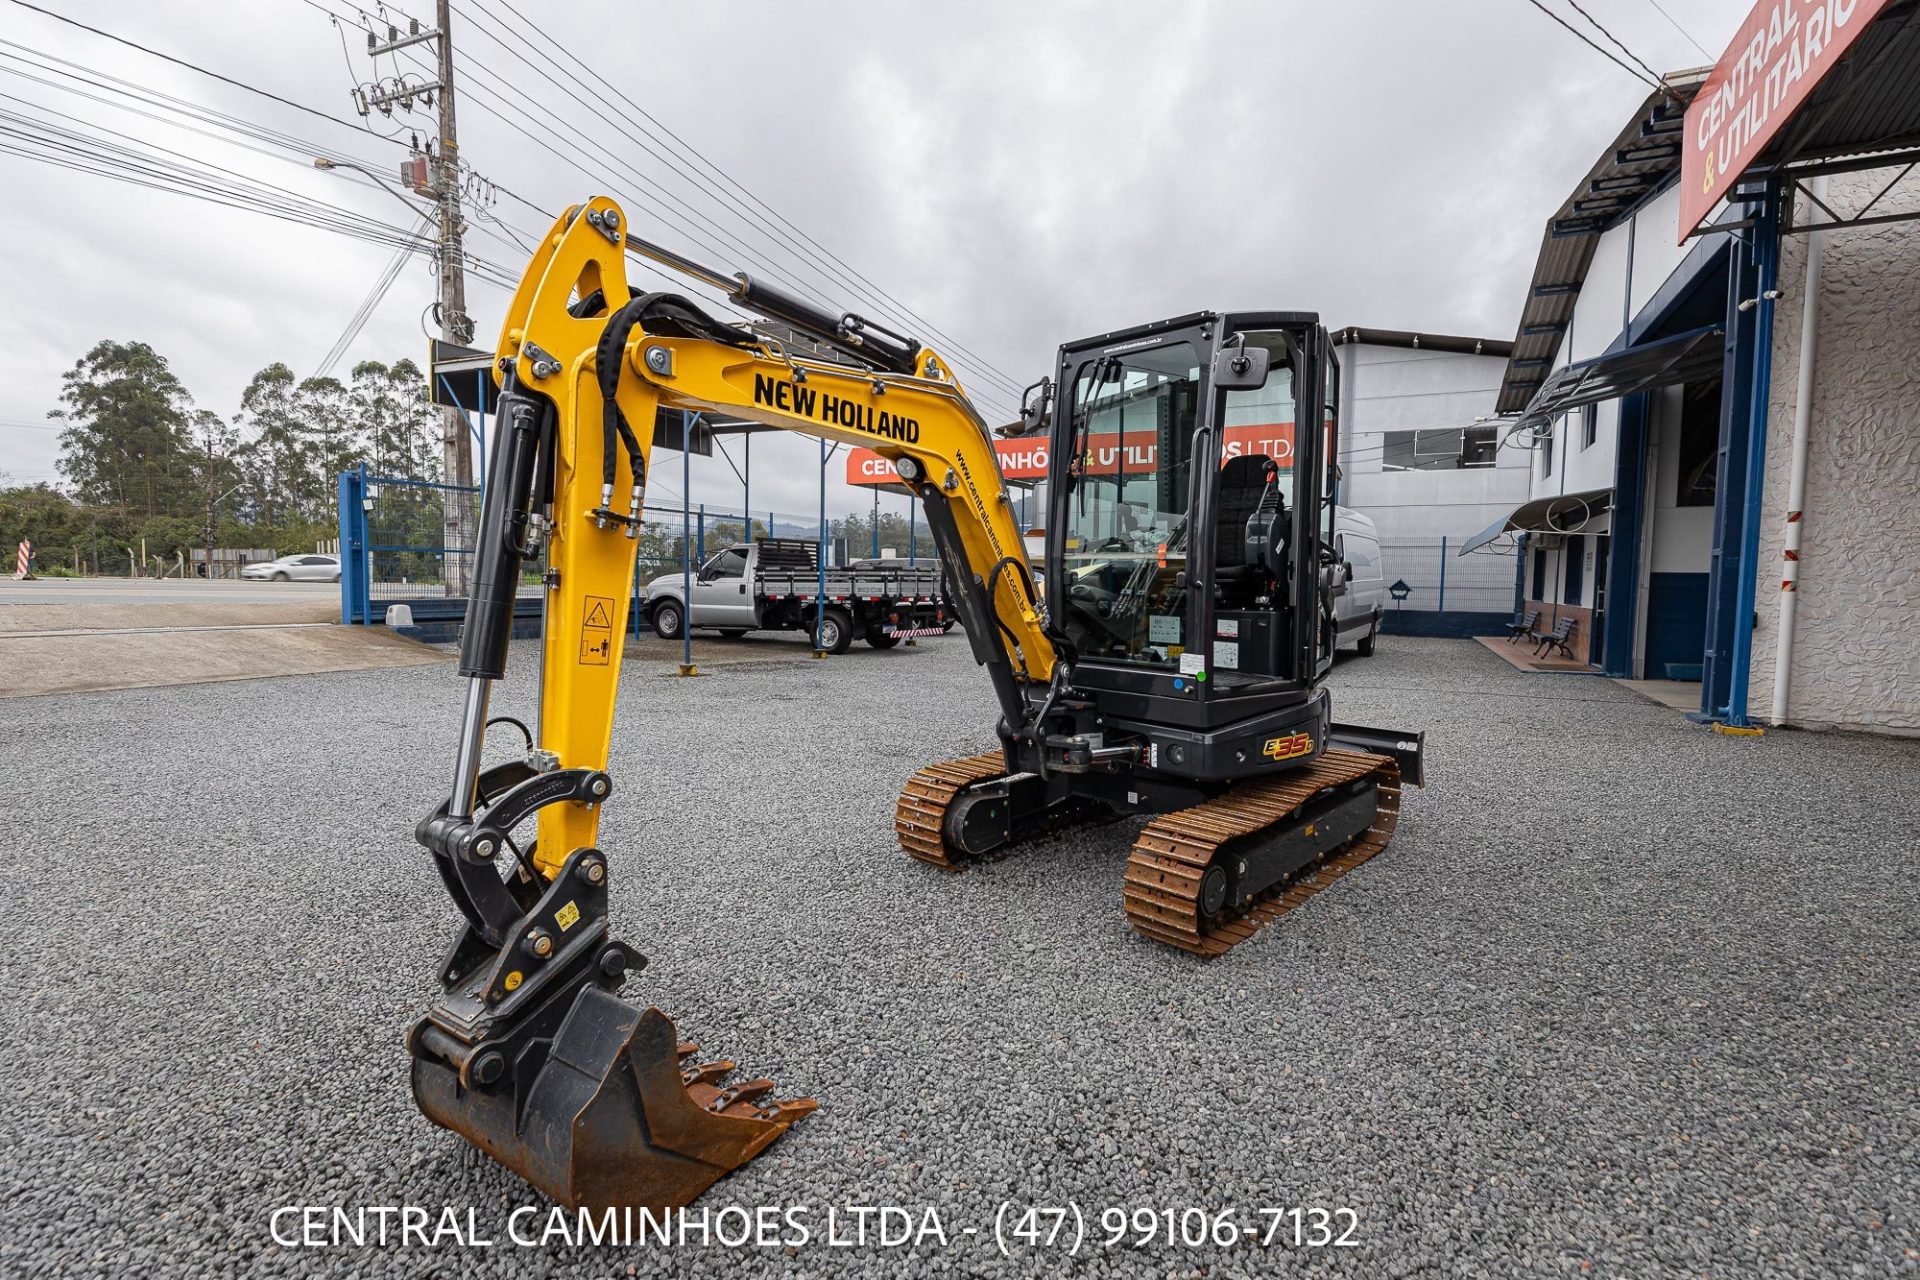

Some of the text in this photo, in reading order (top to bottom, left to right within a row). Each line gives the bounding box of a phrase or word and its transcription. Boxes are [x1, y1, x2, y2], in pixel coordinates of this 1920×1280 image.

[1698, 0, 1798, 151] CENTRAL
[1703, 151, 1715, 194] &
[754, 373, 920, 444] NEW HOLLAND
[861, 459, 898, 476] CEN
[955, 448, 1027, 614] www.centralcaminhes.com.br
